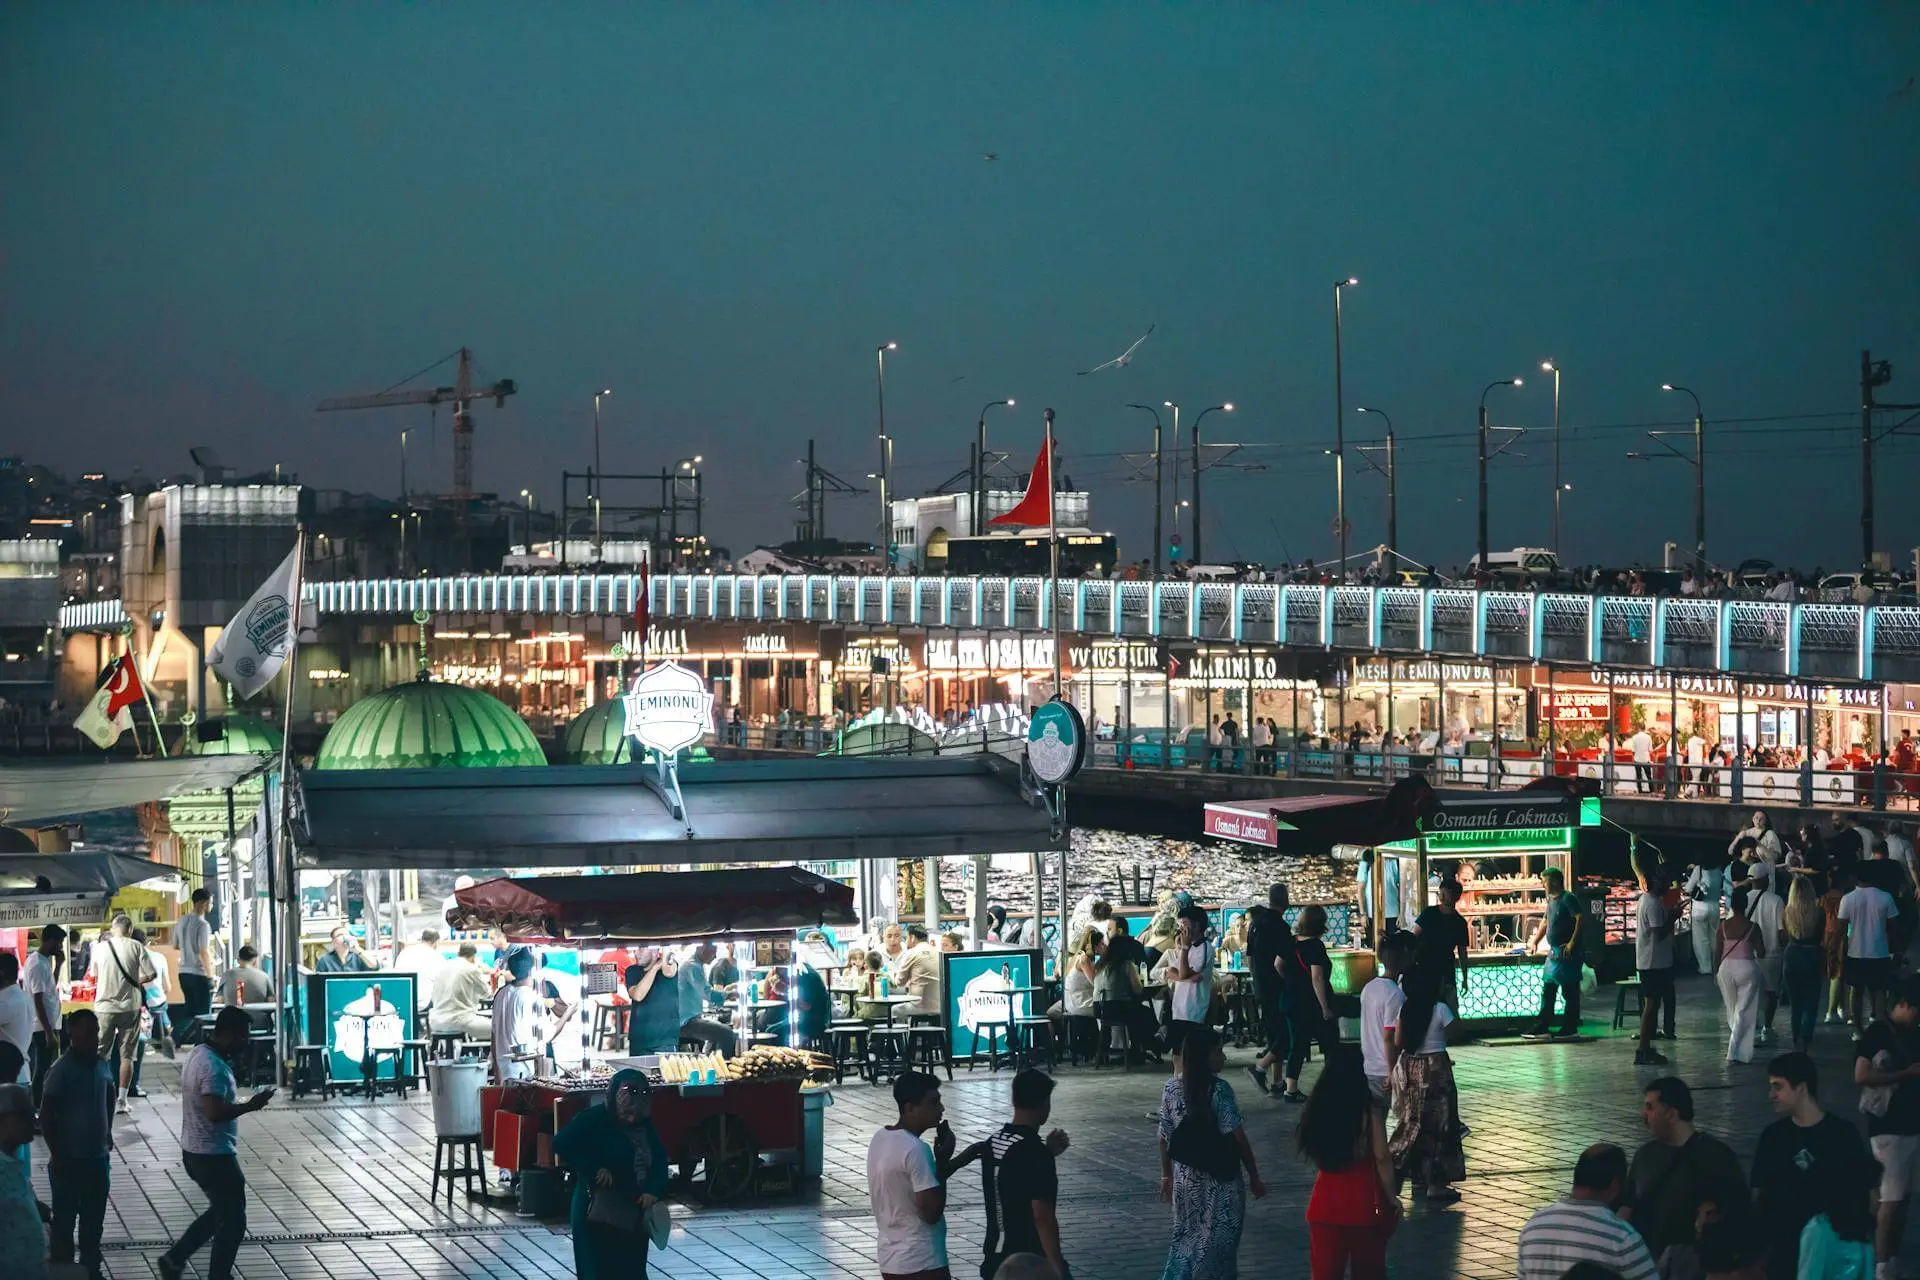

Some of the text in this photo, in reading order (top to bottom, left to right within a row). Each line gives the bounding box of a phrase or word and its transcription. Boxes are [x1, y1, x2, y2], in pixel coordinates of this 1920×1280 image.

[1118, 647, 1158, 667] BALIK
[1433, 808, 1569, 828] Osmanlı Lokması
[0, 904, 40, 921] minönü
